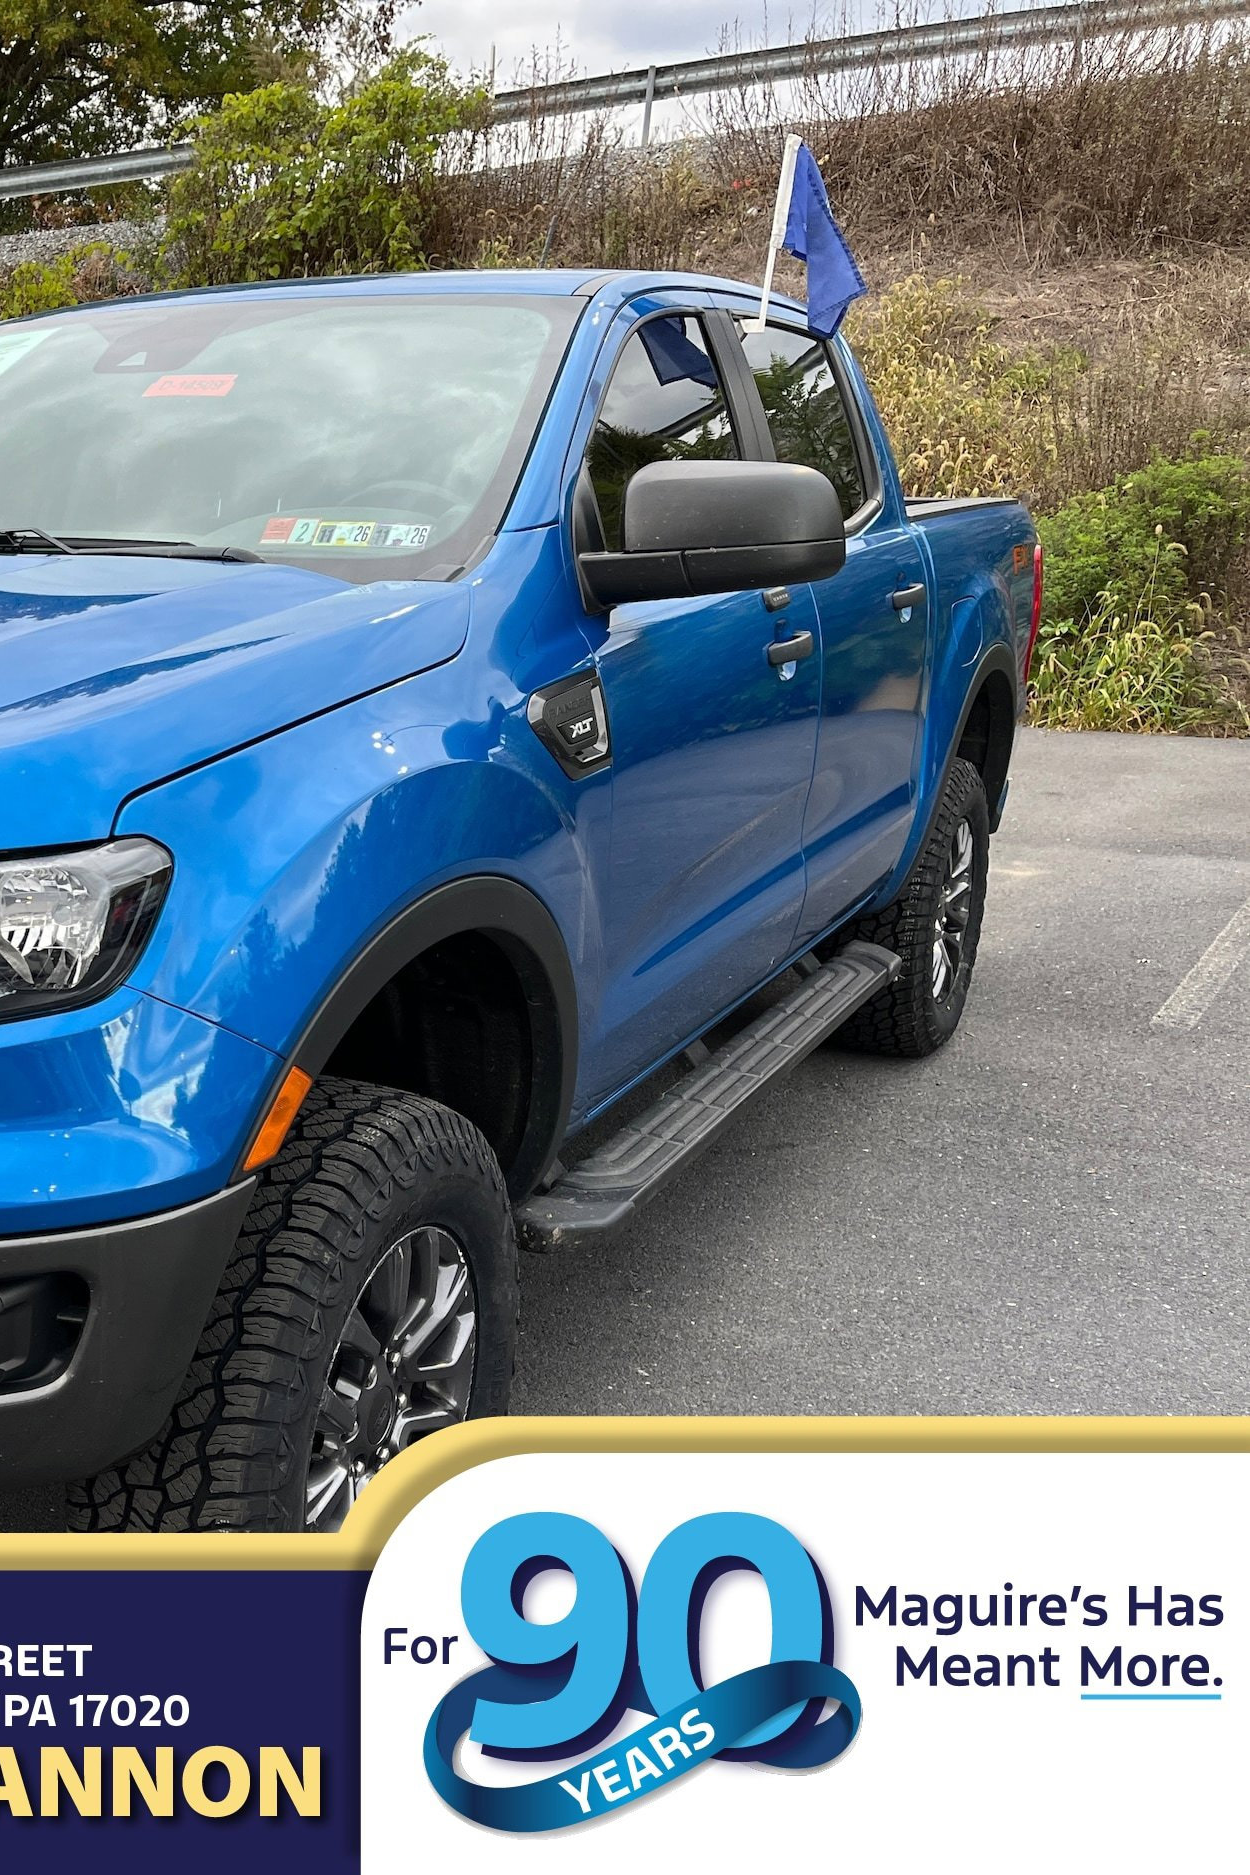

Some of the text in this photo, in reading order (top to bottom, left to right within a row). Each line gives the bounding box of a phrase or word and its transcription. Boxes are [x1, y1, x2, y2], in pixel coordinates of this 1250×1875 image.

[295, 522, 310, 543] 2
[319, 525, 371, 543] 11 26
[410, 527, 428, 544] 26
[569, 717, 594, 738] XLT
